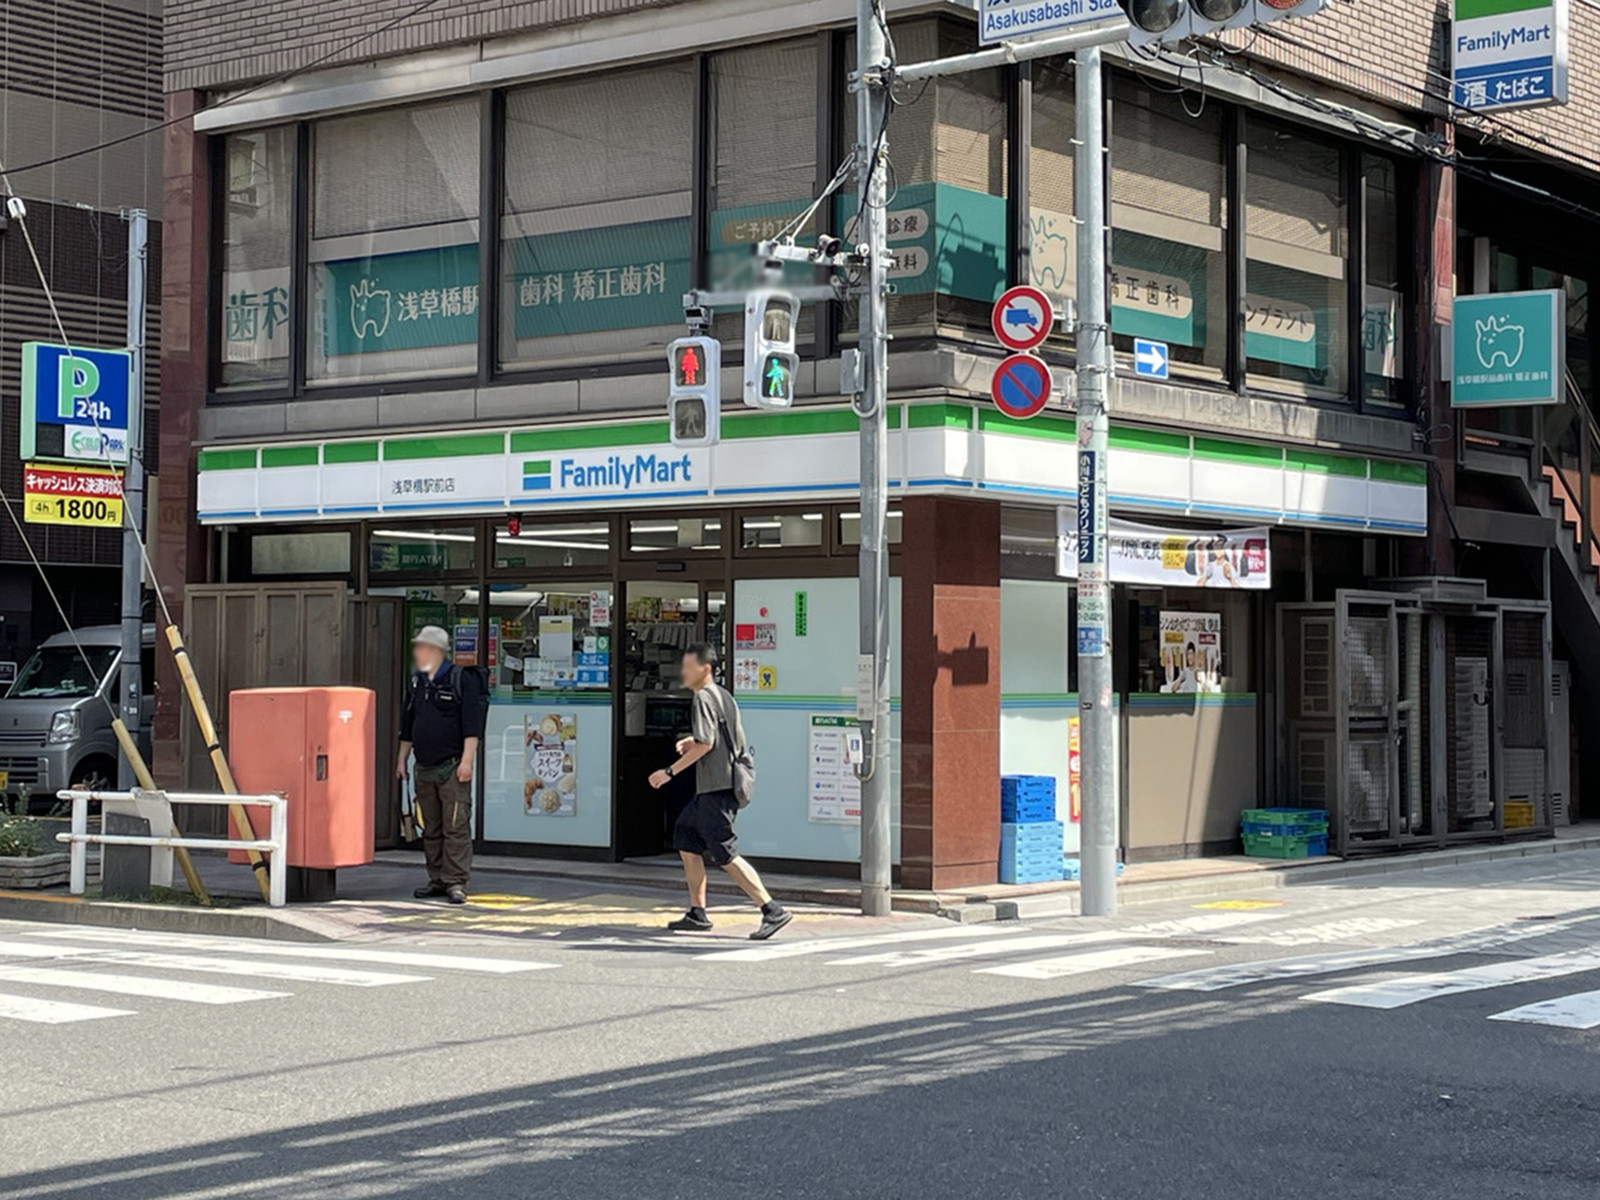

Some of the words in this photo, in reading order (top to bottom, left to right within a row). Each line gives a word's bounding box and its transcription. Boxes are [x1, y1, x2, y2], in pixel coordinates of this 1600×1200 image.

[986, 0, 1083, 31] Asakusabashi
[1457, 24, 1550, 52] FamilyMart
[1463, 80, 1487, 107] 酒
[1495, 76, 1545, 100] たばこ
[520, 273, 564, 307] 歯科
[573, 262, 667, 301] 矯正歯科
[225, 286, 289, 341] 歯科
[1246, 303, 1307, 334] ンプラント
[58, 355, 101, 418] P
[76, 400, 111, 420] 24h
[391, 477, 456, 495] 浅草橋駅前店
[560, 453, 692, 490] FamilyMart
[35, 503, 49, 513] 4h
[1079, 454, 1091, 559] 小川こどもクリニック
